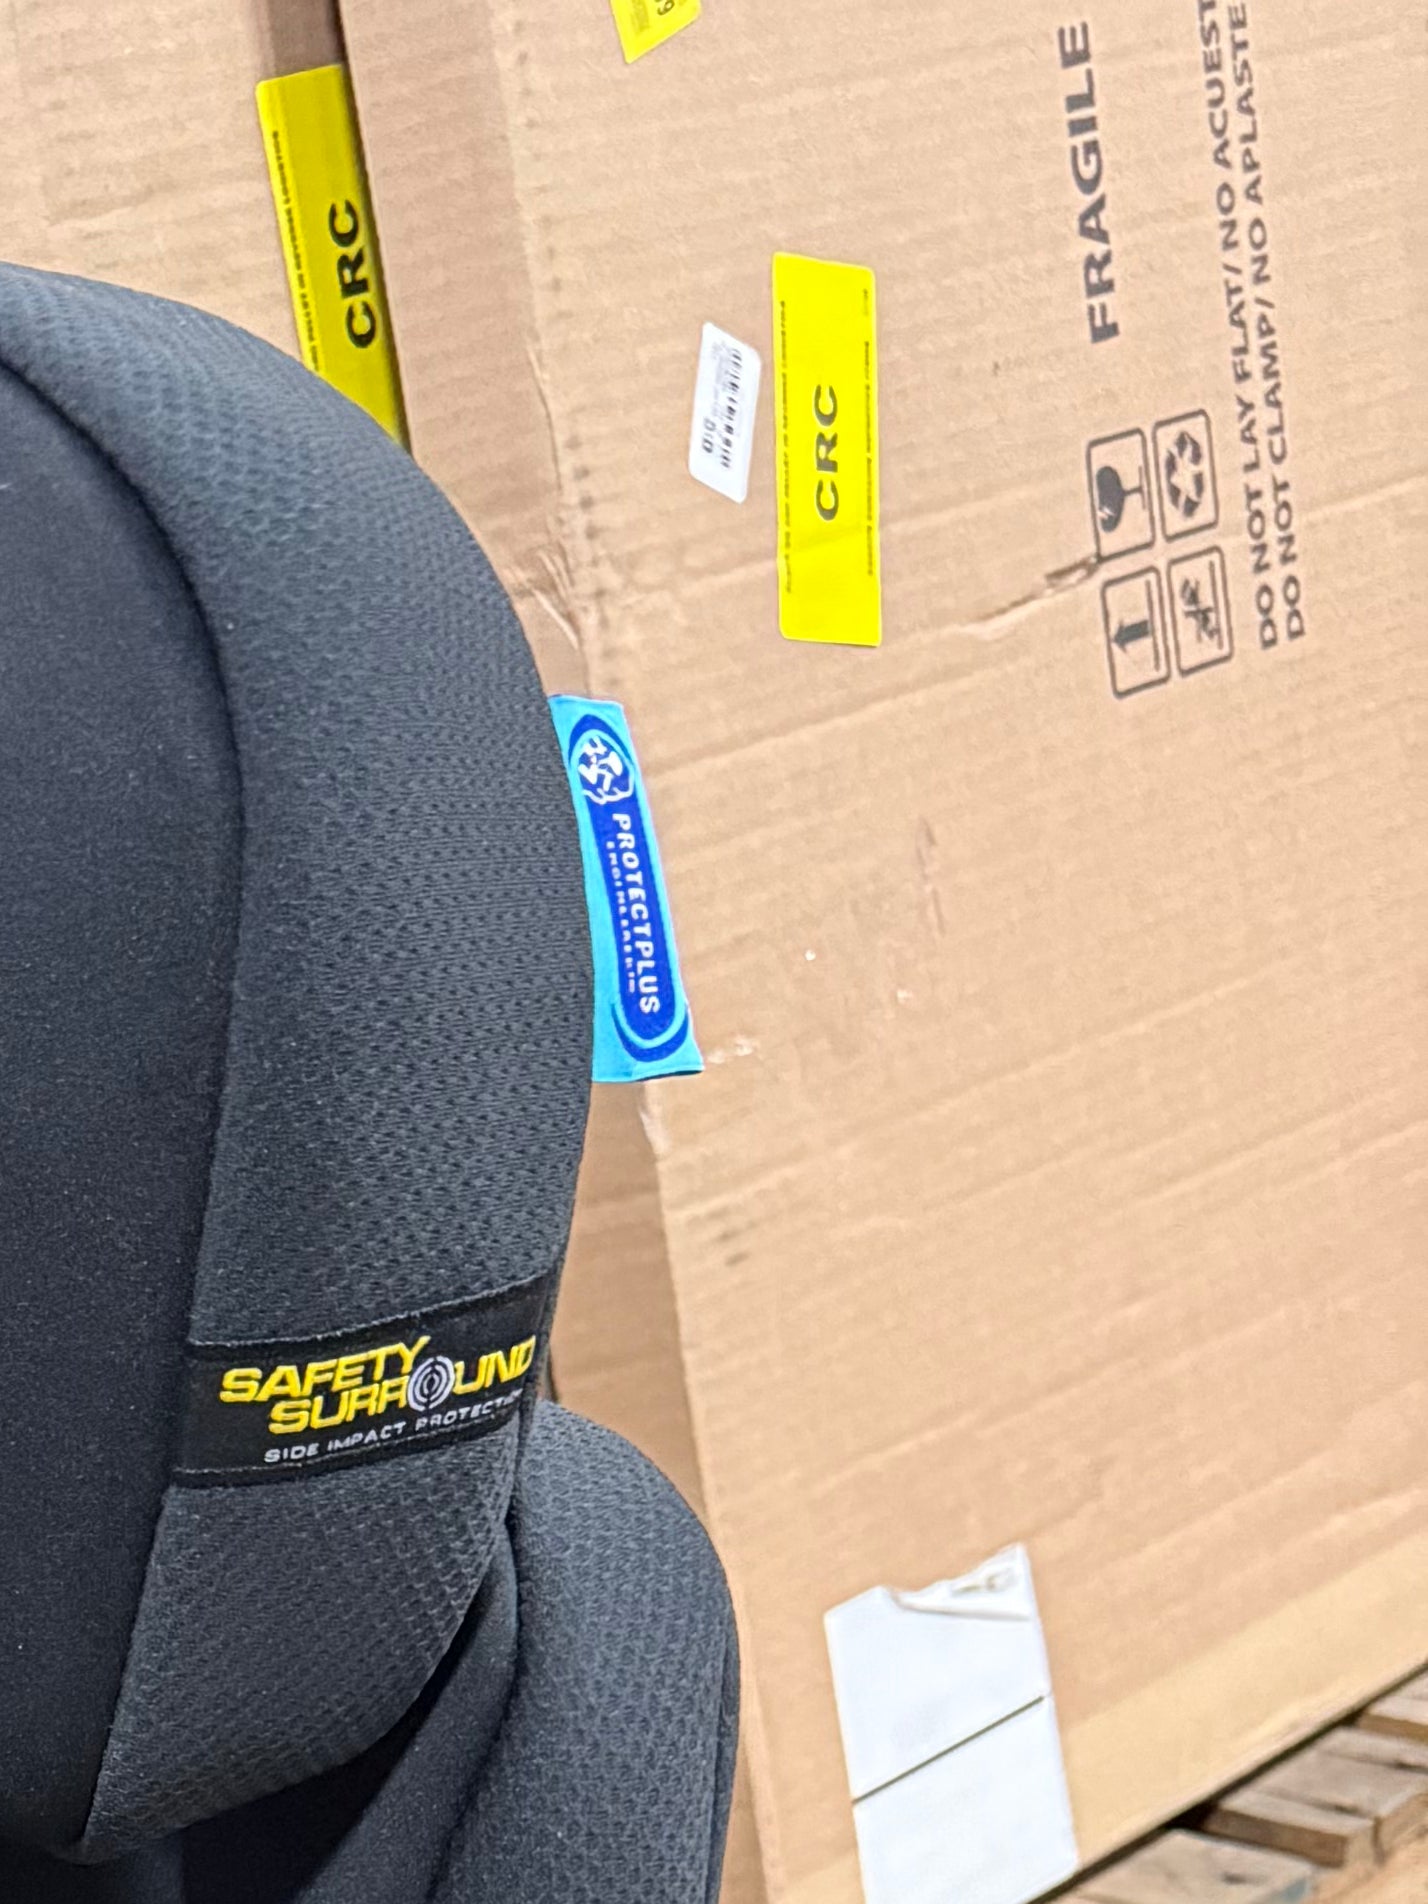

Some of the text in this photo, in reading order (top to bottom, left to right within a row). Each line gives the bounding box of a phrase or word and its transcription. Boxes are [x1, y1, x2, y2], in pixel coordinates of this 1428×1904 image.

[1228, 1, 1264, 206] APLASTE
[1057, 21, 1121, 344] FRAGILE
[1216, 181, 1240, 251] NO
[329, 199, 378, 349] CRC
[1248, 216, 1272, 286] NO
[813, 383, 840, 521] CRC
[1235, 393, 1261, 472] LAY
[1243, 482, 1271, 575] NOT
[1271, 472, 1298, 566] NOT
[1254, 583, 1279, 651] DO
[1281, 574, 1306, 642] DO
[612, 812, 661, 1014] PROTECTPLUS
[219, 1335, 432, 1403] SAFETY
[267, 1334, 537, 1435] SURROUND
[264, 1442, 320, 1463] SIDE
[327, 1420, 407, 1451] IMPACT
